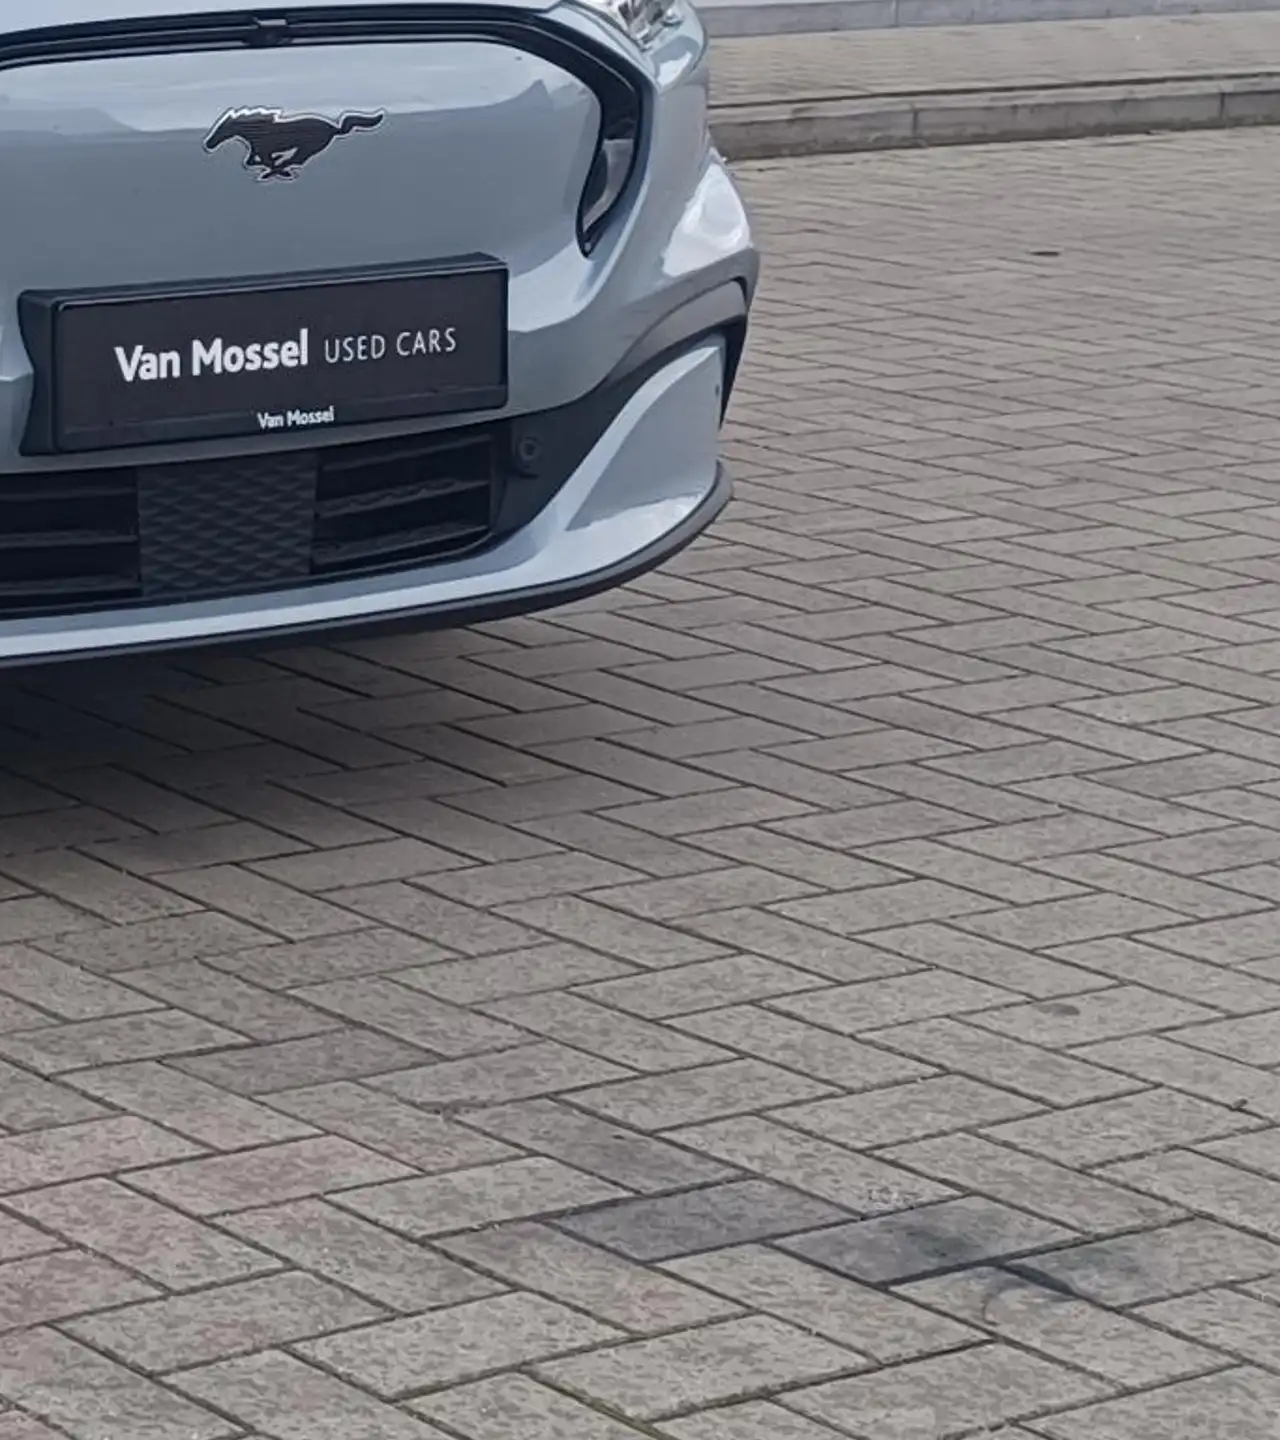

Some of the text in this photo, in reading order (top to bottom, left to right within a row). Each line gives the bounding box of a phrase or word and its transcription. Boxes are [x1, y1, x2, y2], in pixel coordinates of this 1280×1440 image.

[114, 326, 457, 382] Van Mossel USED CARS
[257, 404, 335, 431] Van Mossel
